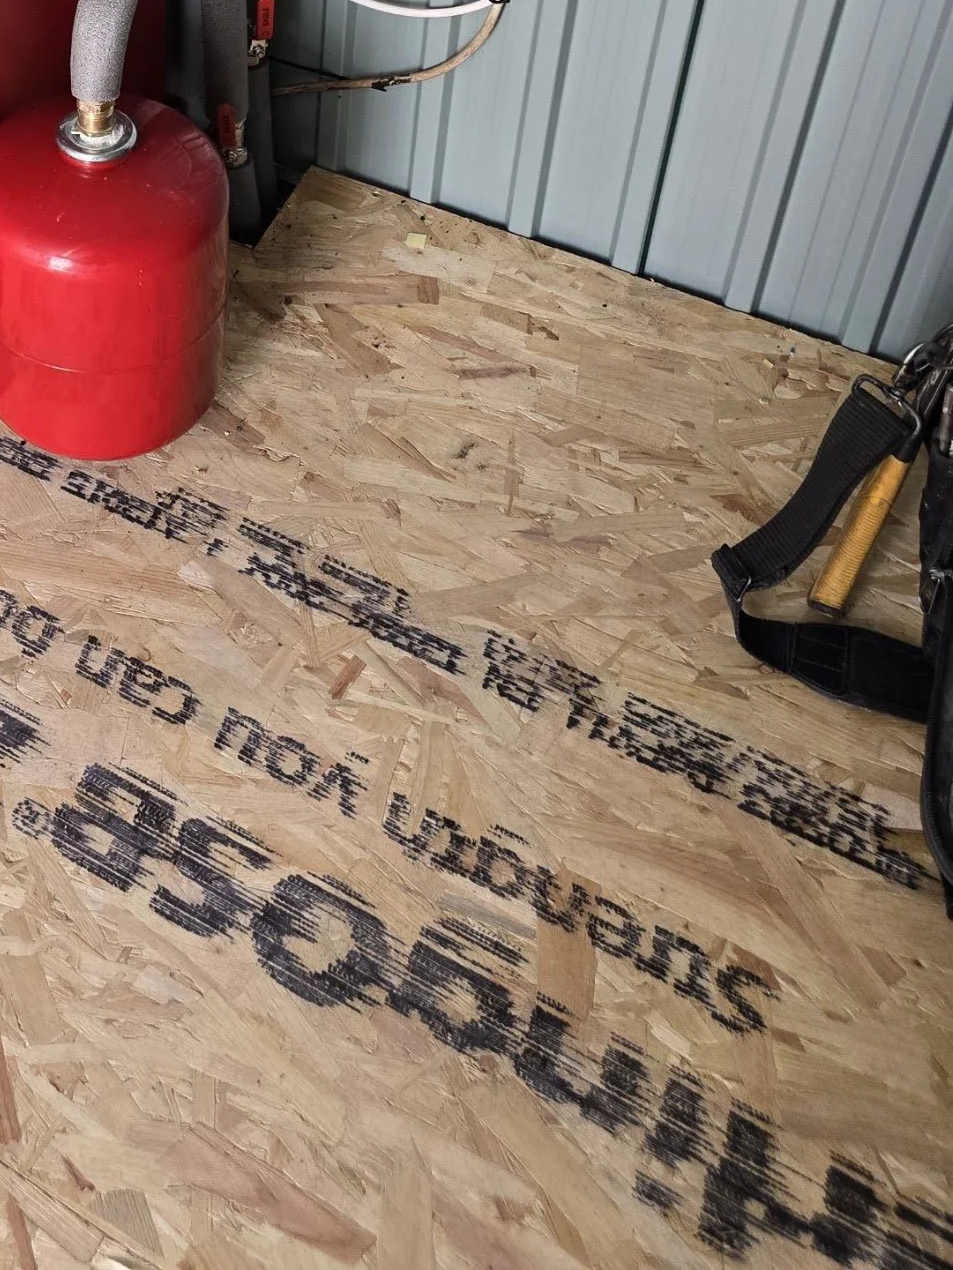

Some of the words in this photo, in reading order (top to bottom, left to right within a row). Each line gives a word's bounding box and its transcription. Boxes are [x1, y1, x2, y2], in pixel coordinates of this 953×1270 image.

[74, 634, 199, 726] can
[213, 706, 370, 820] you
[382, 792, 782, 1035] Strength
